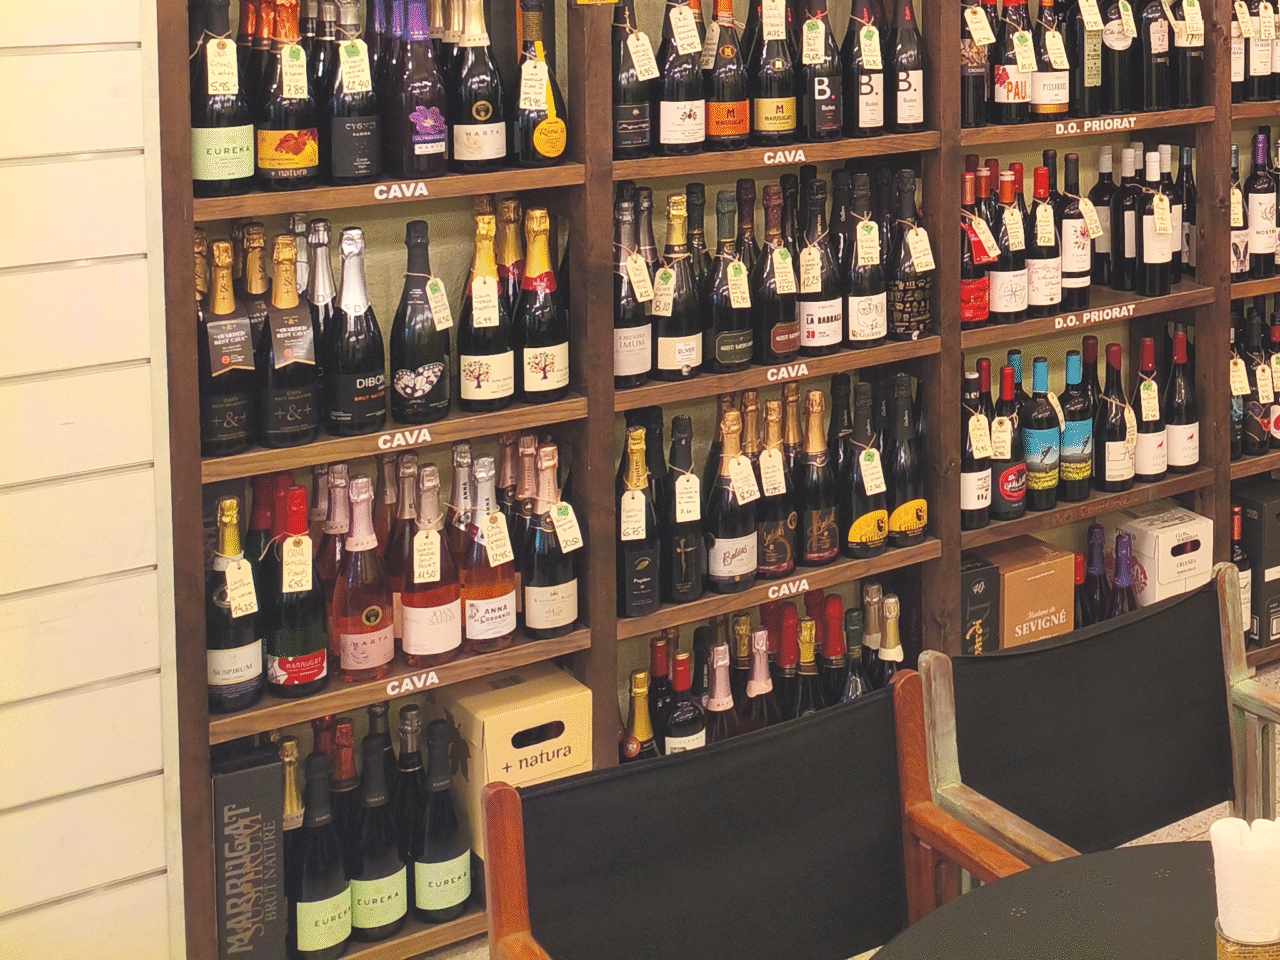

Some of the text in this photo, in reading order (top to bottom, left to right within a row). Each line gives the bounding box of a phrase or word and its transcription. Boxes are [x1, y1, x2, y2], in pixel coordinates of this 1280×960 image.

[1006, 80, 1027, 100] PAU
[466, 128, 500, 139] MARTA
[1055, 117, 1137, 135] D.O. PRIORAT
[206, 144, 252, 155] EUREKA
[763, 149, 806, 165] CAVA
[374, 182, 429, 200] CAVA
[1055, 304, 1136, 329] D.O. PRIORAT
[766, 363, 809, 381] CAVA
[378, 428, 432, 449] CAVA
[767, 578, 810, 599] CAVA
[484, 603, 508, 615] ANNA
[1014, 609, 1067, 638] SEVIGNÉ
[211, 661, 253, 677] SUSPIRUM
[386, 671, 439, 696] CAVA
[518, 742, 574, 770] natura
[263, 819, 277, 922] BRUT NATURE
[428, 870, 469, 890] EUREKA
[356, 890, 400, 908] EUREKA
